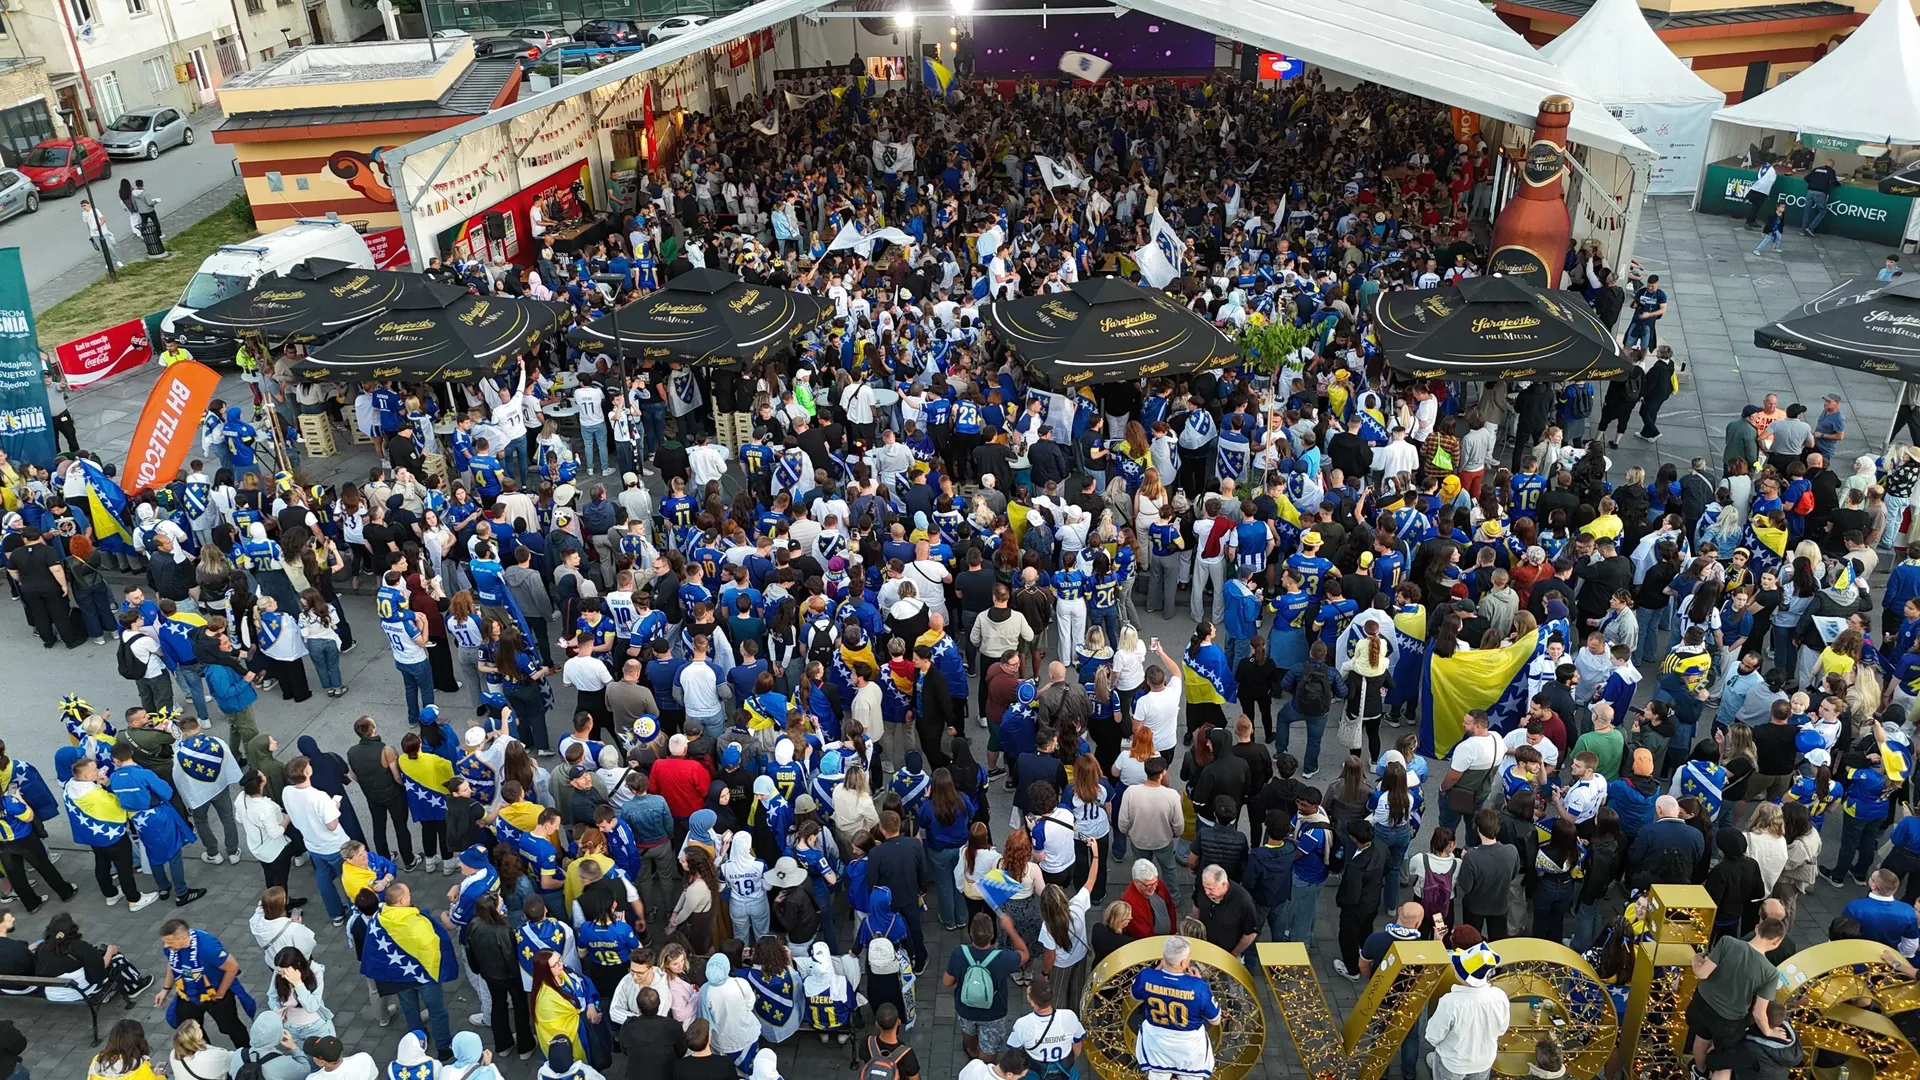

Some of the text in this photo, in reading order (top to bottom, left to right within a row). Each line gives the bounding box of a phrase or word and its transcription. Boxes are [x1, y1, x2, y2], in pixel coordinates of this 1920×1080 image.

[1778, 193, 1817, 209] FOO
[1493, 259, 1539, 275] Sarajevsko
[330, 274, 371, 298] Sarajevsko
[253, 290, 307, 302] Sarajevsko
[728, 288, 760, 314] Sarajevsko
[458, 299, 490, 326] Sarajevsko
[649, 302, 707, 315] Sarajevsko
[1041, 299, 1078, 322] Sarajevsko
[374, 319, 437, 336] Sarajevsko
[654, 315, 689, 325] PREMIUM
[1100, 311, 1157, 333] Sarajevsko
[1471, 315, 1541, 335] Sarajevsko
[380, 334, 418, 343] PREMIUM
[1115, 328, 1155, 338] PREMIUM
[1485, 332, 1532, 340] PREMIUM
[1770, 338, 1807, 351] Sarajevsko
[0, 360, 32, 370] ledajmo
[1138, 360, 1169, 376] Sarajevsko
[1499, 367, 1537, 379] Sarajevsko
[1587, 367, 1625, 379] Sarajevsko
[1861, 359, 1901, 372] Sarajevsko
[1063, 369, 1094, 385] Sarajevsko
[1412, 368, 1447, 379] Sarajevsko
[0, 380, 30, 390] Zajedno
[166, 377, 191, 416] BH
[15, 406, 43, 416] FROM
[581, 402, 595, 416] 11
[958, 405, 978, 426] 23
[0, 412, 47, 431] BSNIA
[507, 414, 521, 427] 11
[935, 413, 946, 425] 11
[747, 456, 762, 474] 11
[475, 470, 487, 488] 4
[1519, 489, 1540, 510] 19
[675, 510, 691, 527] 11
[702, 560, 717, 578] 19
[1062, 588, 1079, 601] 11
[1096, 588, 1115, 609] 20
[613, 607, 631, 625] 10
[387, 632, 405, 652] 19
[455, 630, 476, 647] 11
[1091, 701, 1103, 715] 11
[776, 770, 797, 781] DEDIĆ
[778, 781, 796, 801] 7
[1081, 802, 1100, 821] 10
[734, 879, 756, 897] 19
[594, 950, 622, 966] 19
[809, 1005, 842, 1030] 11
[1147, 996, 1189, 1028] 20
[1039, 1046, 1063, 1062] 19
